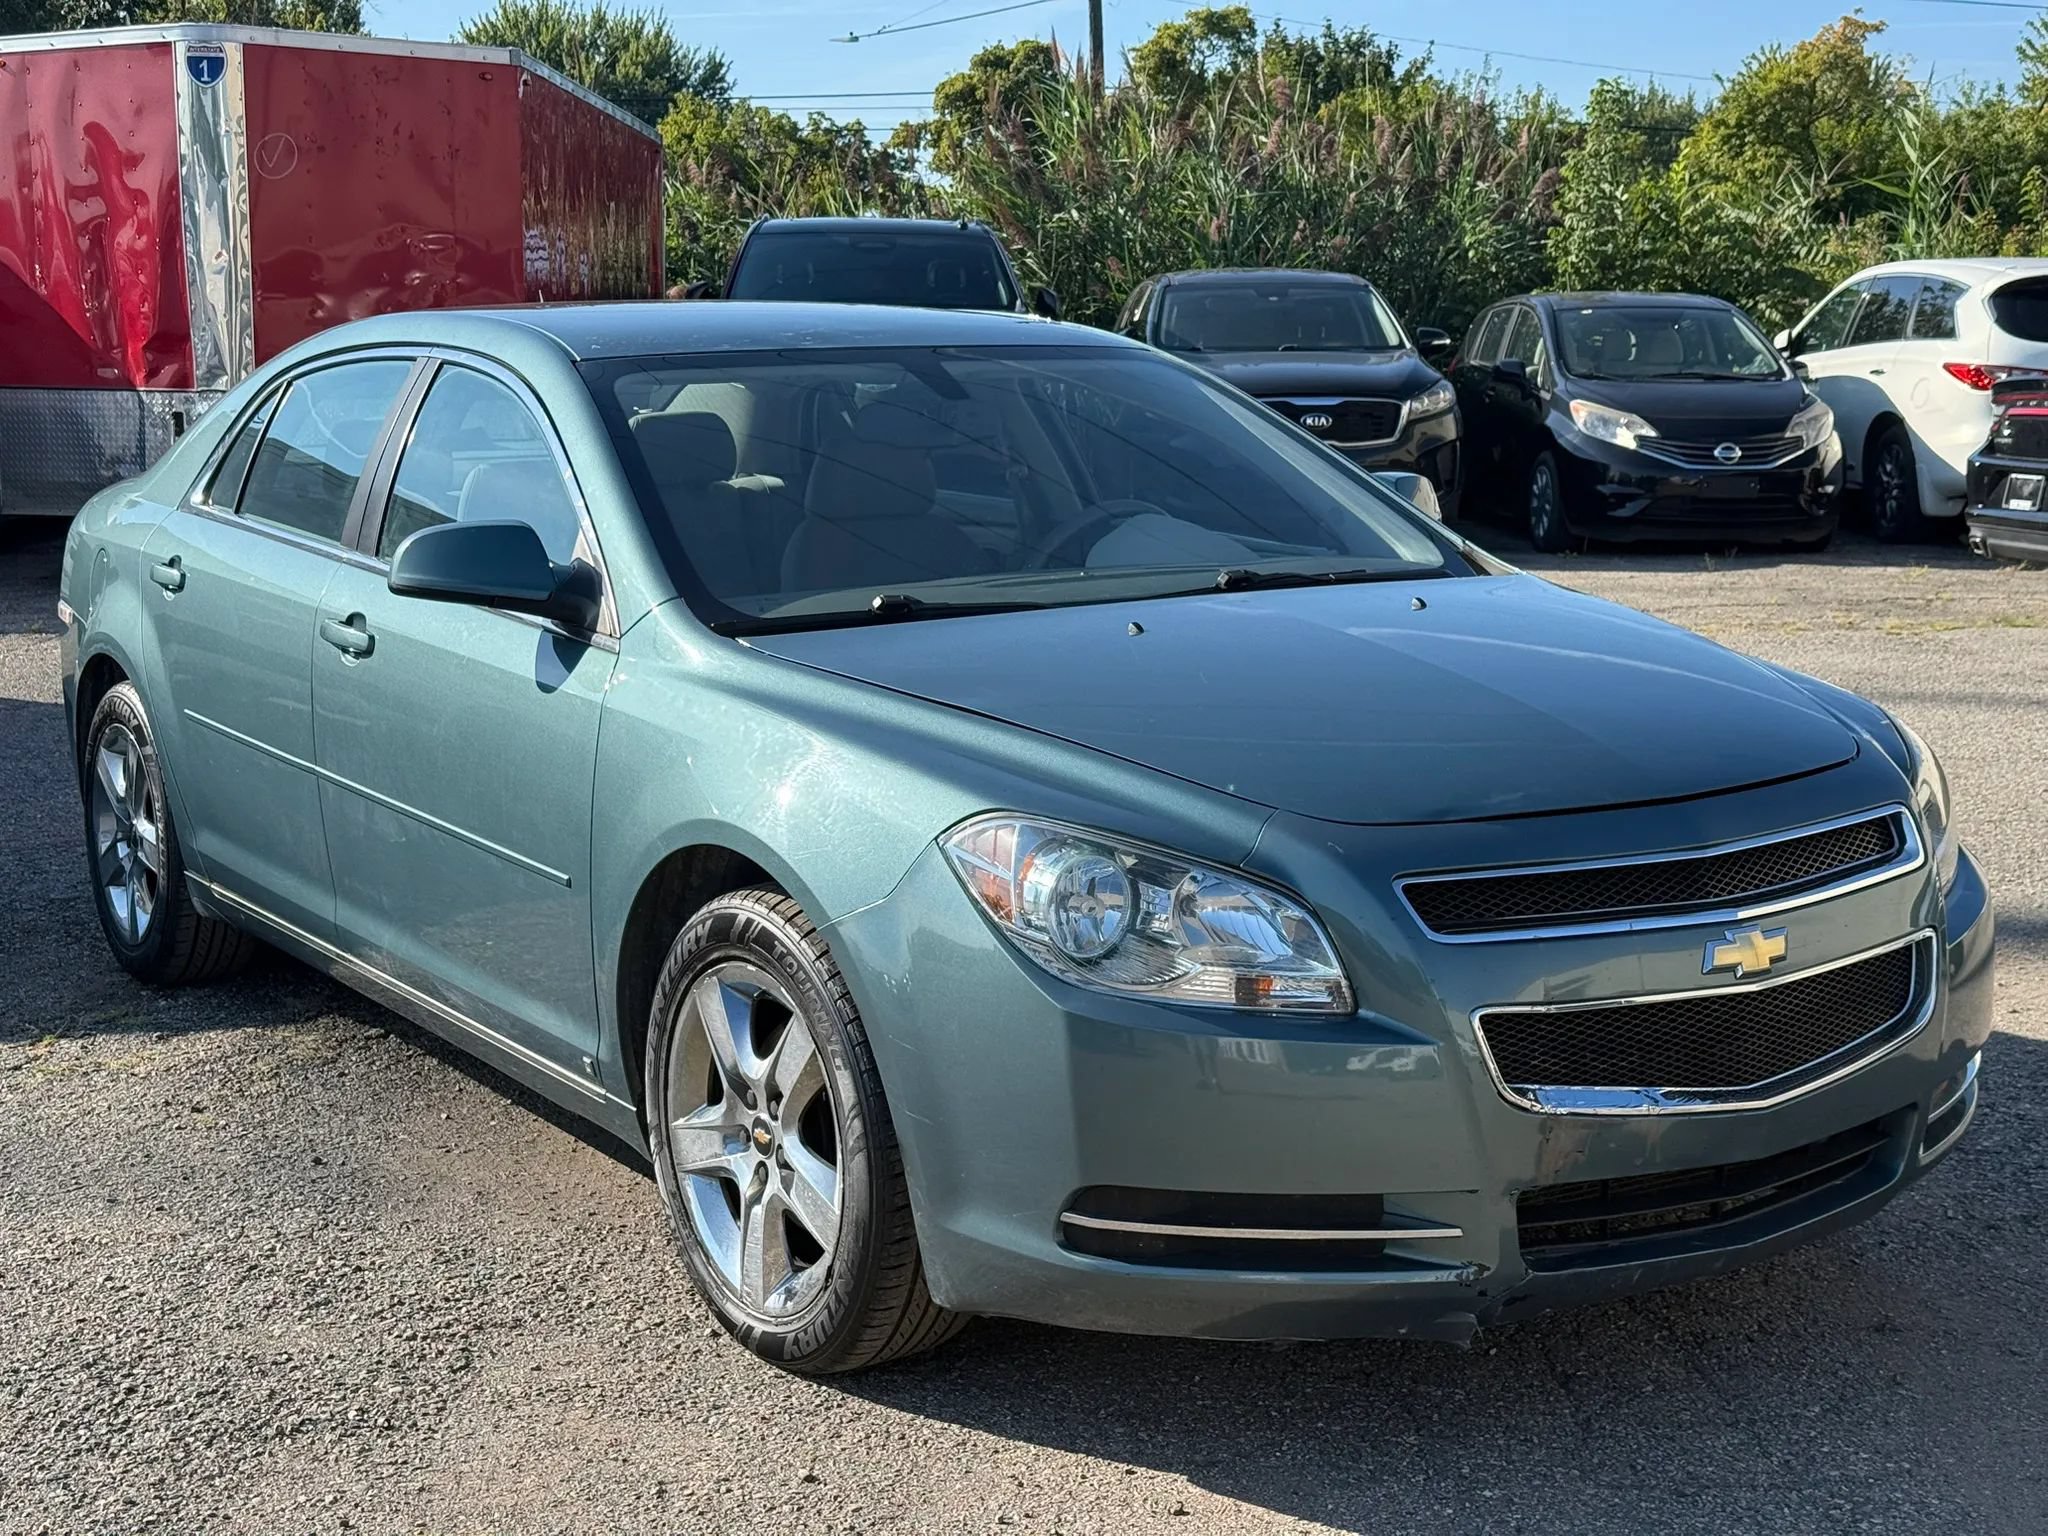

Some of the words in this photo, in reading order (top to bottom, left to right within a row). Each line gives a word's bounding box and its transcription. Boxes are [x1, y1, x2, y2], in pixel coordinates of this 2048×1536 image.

[199, 59, 212, 81] 1
[1305, 416, 1328, 427] KIA
[771, 940, 847, 1071] TOURING
